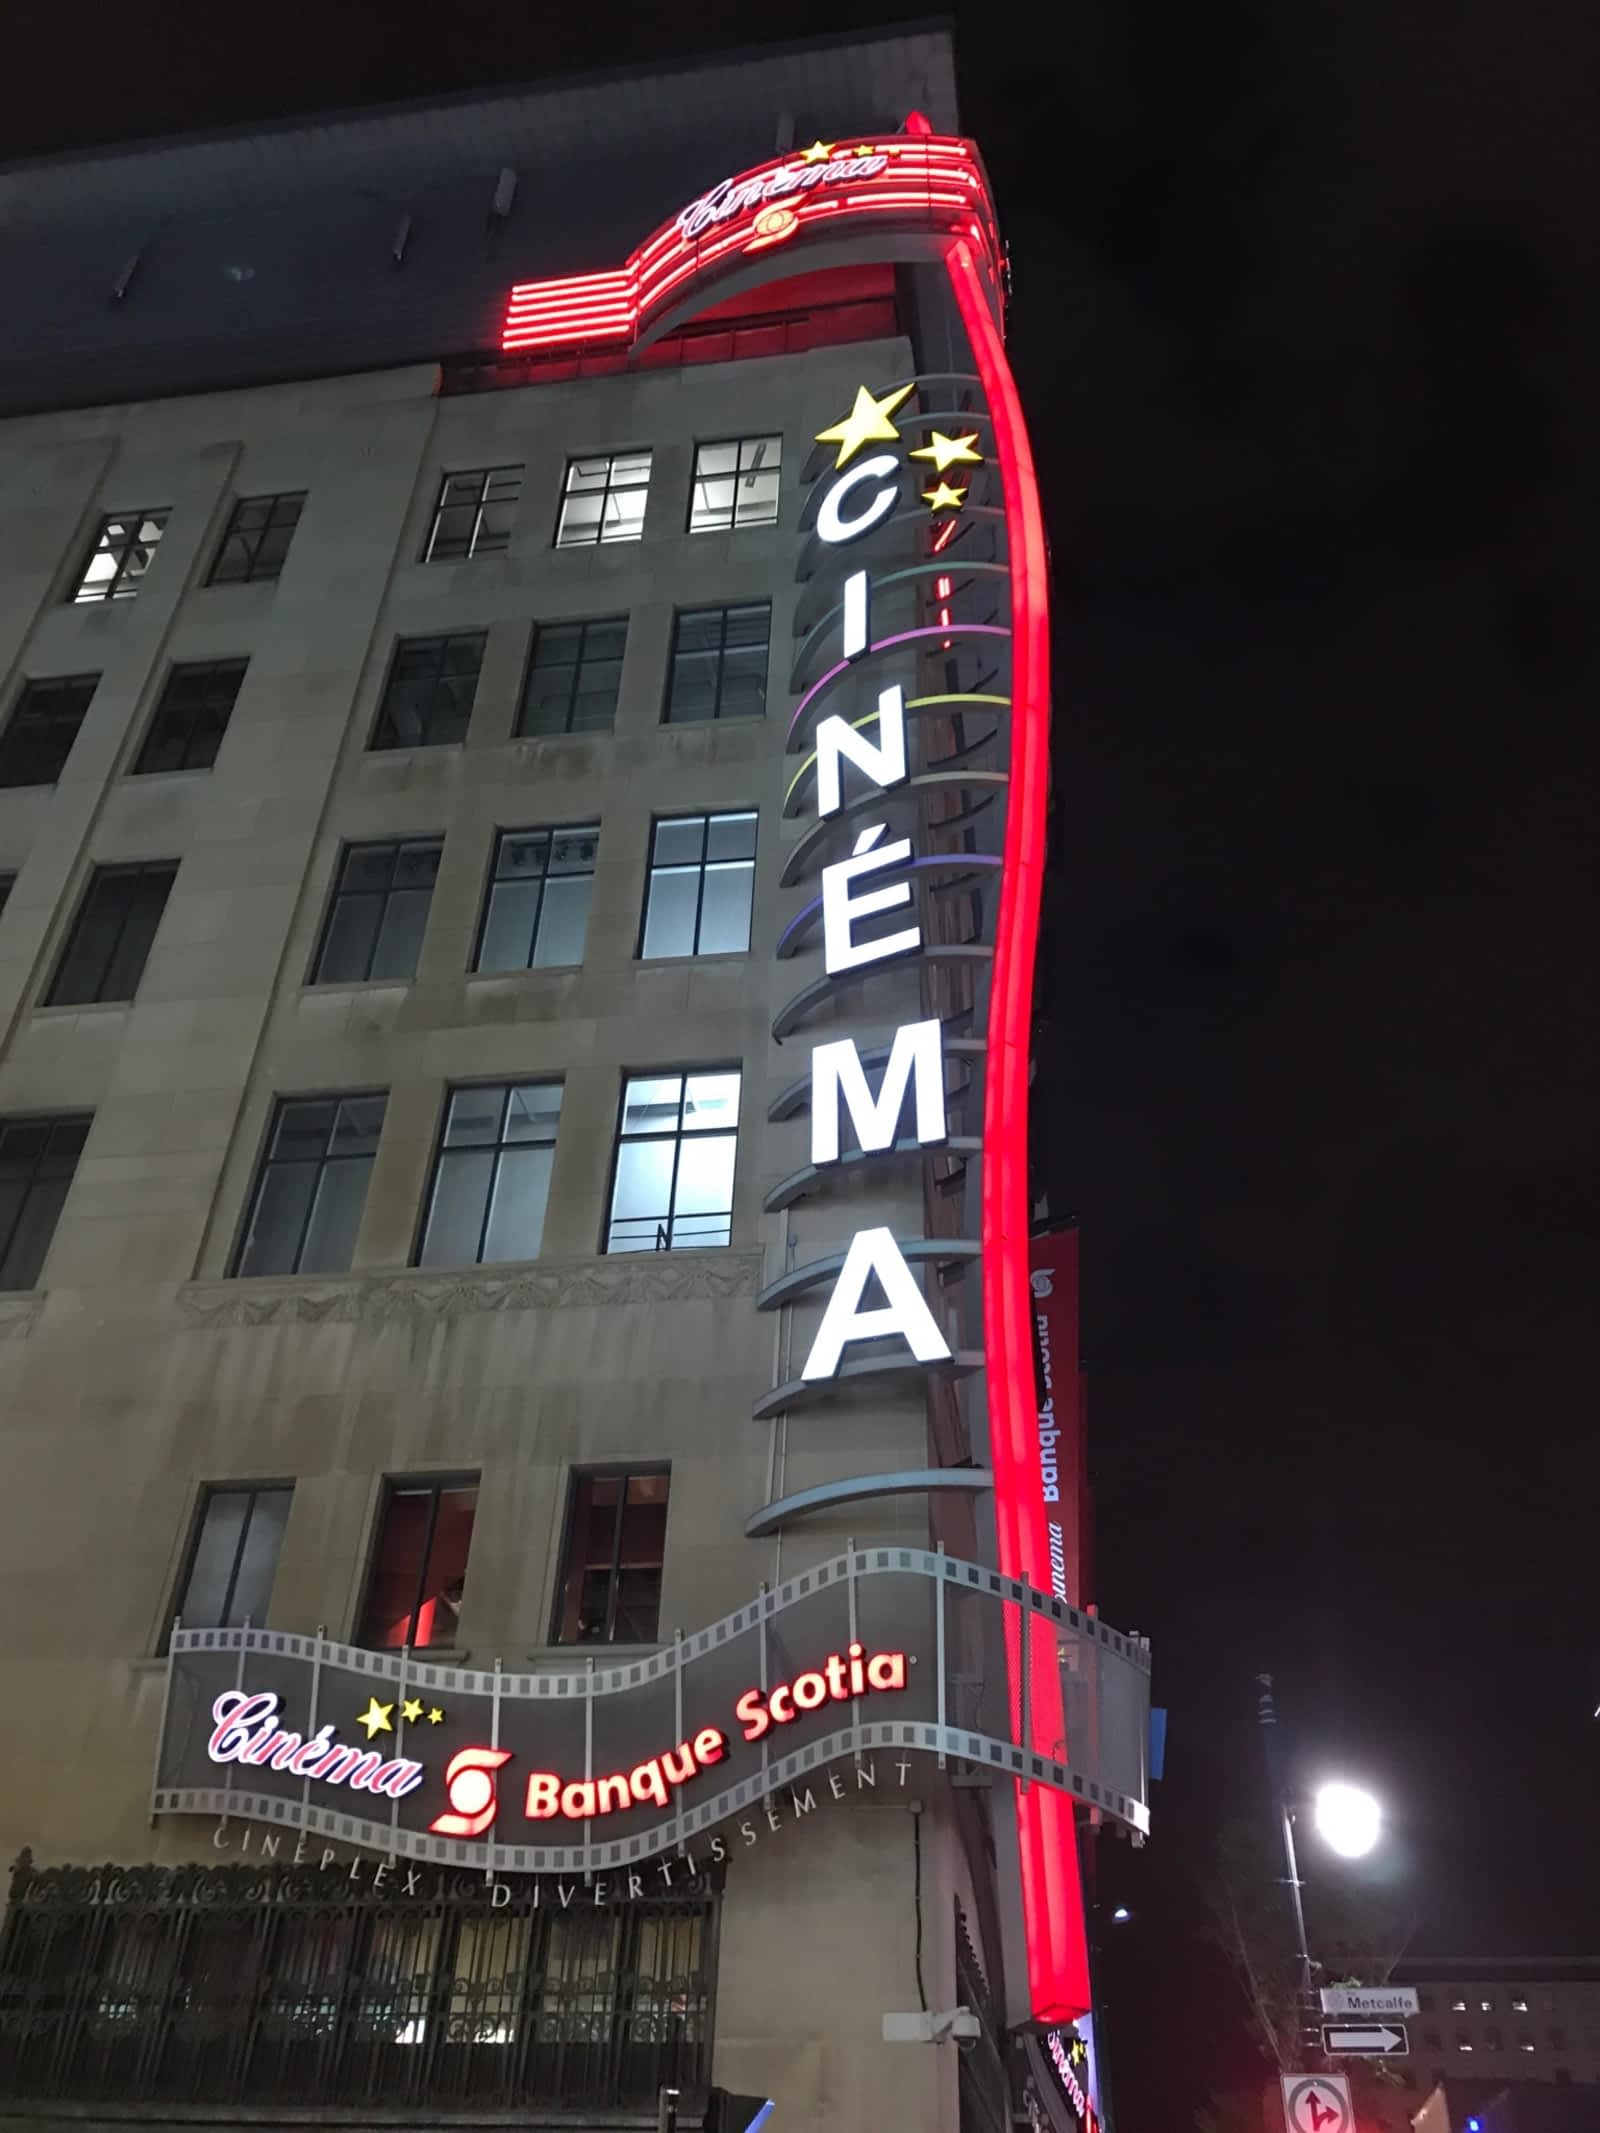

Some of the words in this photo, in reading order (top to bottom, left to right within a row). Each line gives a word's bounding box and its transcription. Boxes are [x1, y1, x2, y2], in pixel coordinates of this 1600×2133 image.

[800, 454, 953, 1384] CINÉMA
[208, 1690, 424, 1799] Cinéma
[523, 1727, 725, 1820] Banque
[735, 1642, 907, 1742] Scotia
[491, 1762, 912, 1909] DIVERTISSEMENT
[1347, 1996, 1413, 2009] Metcalfe
